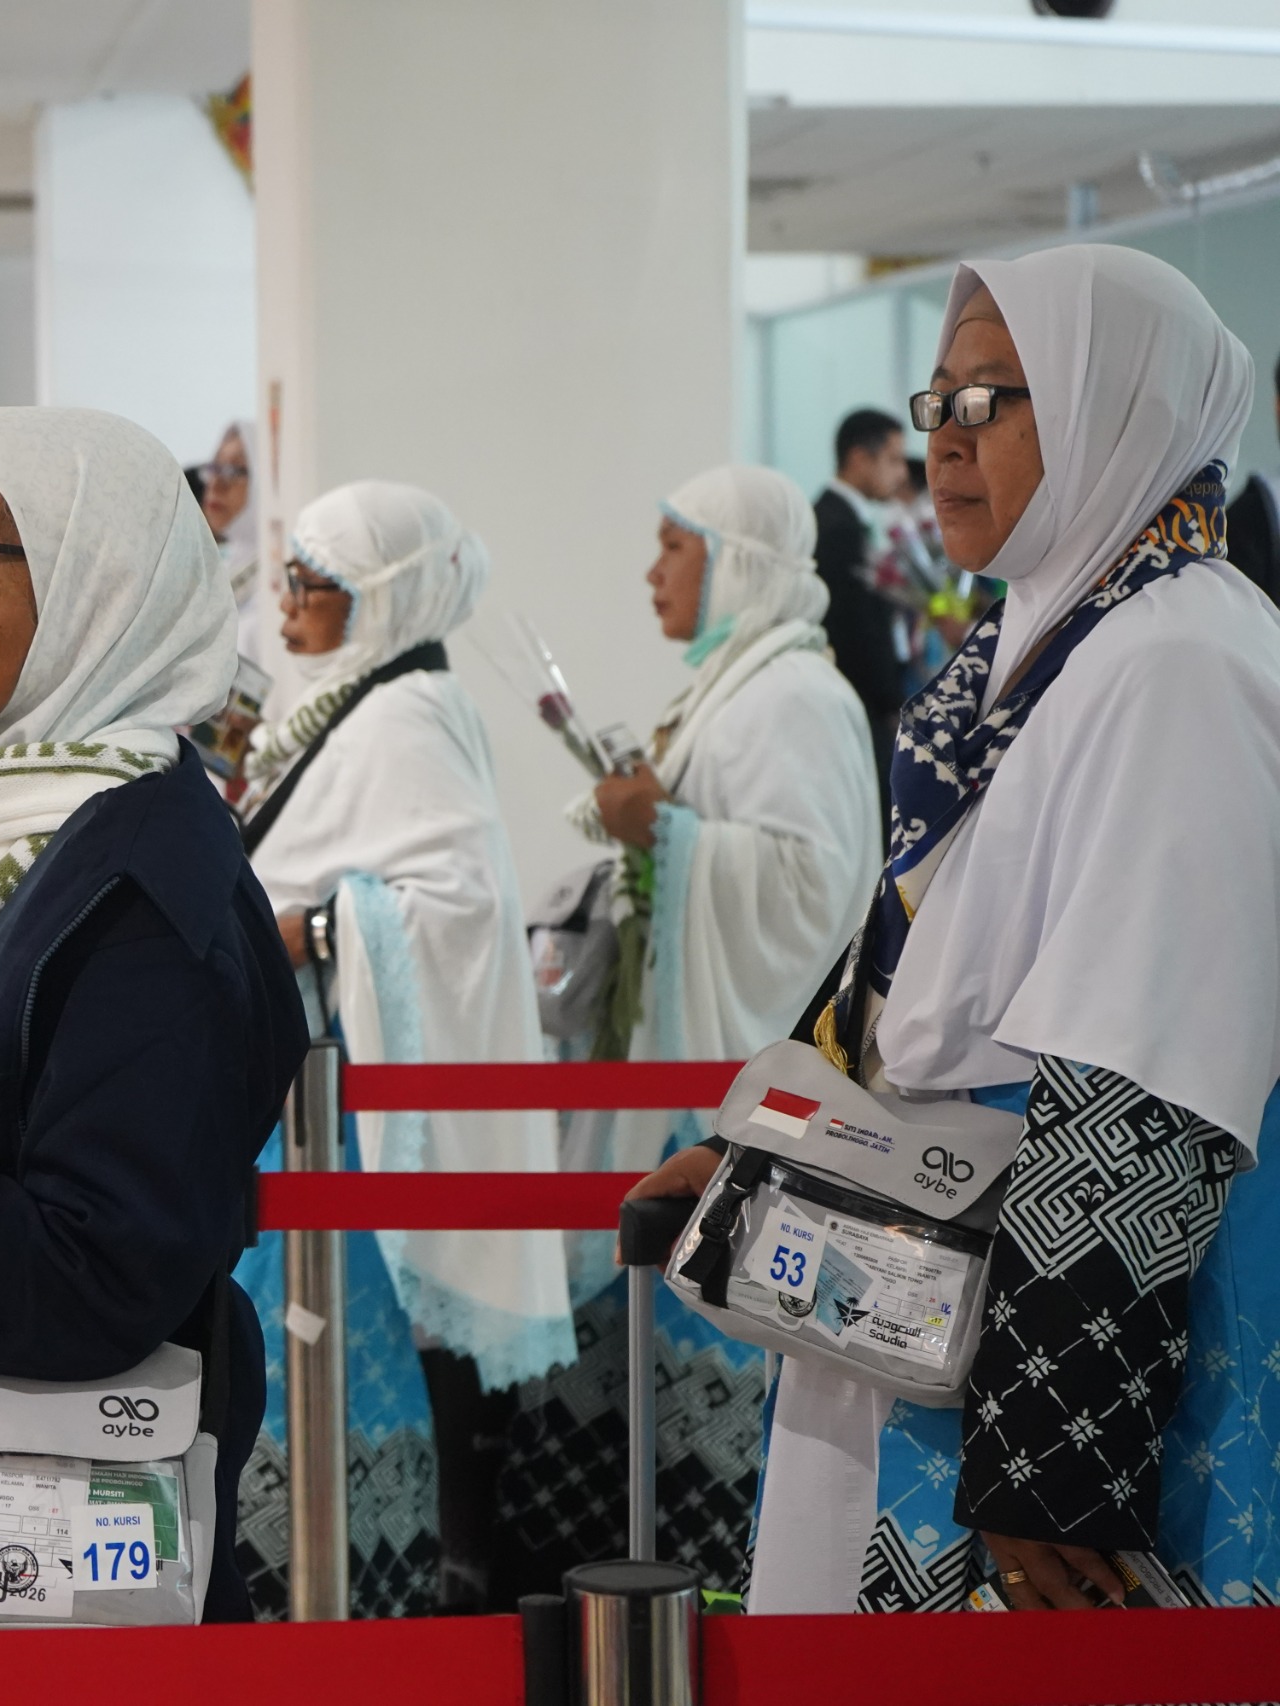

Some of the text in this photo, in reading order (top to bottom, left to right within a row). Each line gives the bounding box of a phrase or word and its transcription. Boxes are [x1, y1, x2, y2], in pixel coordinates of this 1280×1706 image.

[914, 1172, 957, 1199] aybe
[780, 1222, 815, 1242] NO. KURSI
[769, 1244, 807, 1287] 53
[872, 1313, 922, 1338] السعودية
[102, 1422, 155, 1438] aybe
[92, 1489, 124, 1498] MURSITI
[95, 1516, 141, 1527] NO. KURSI
[83, 1541, 150, 1582] 179
